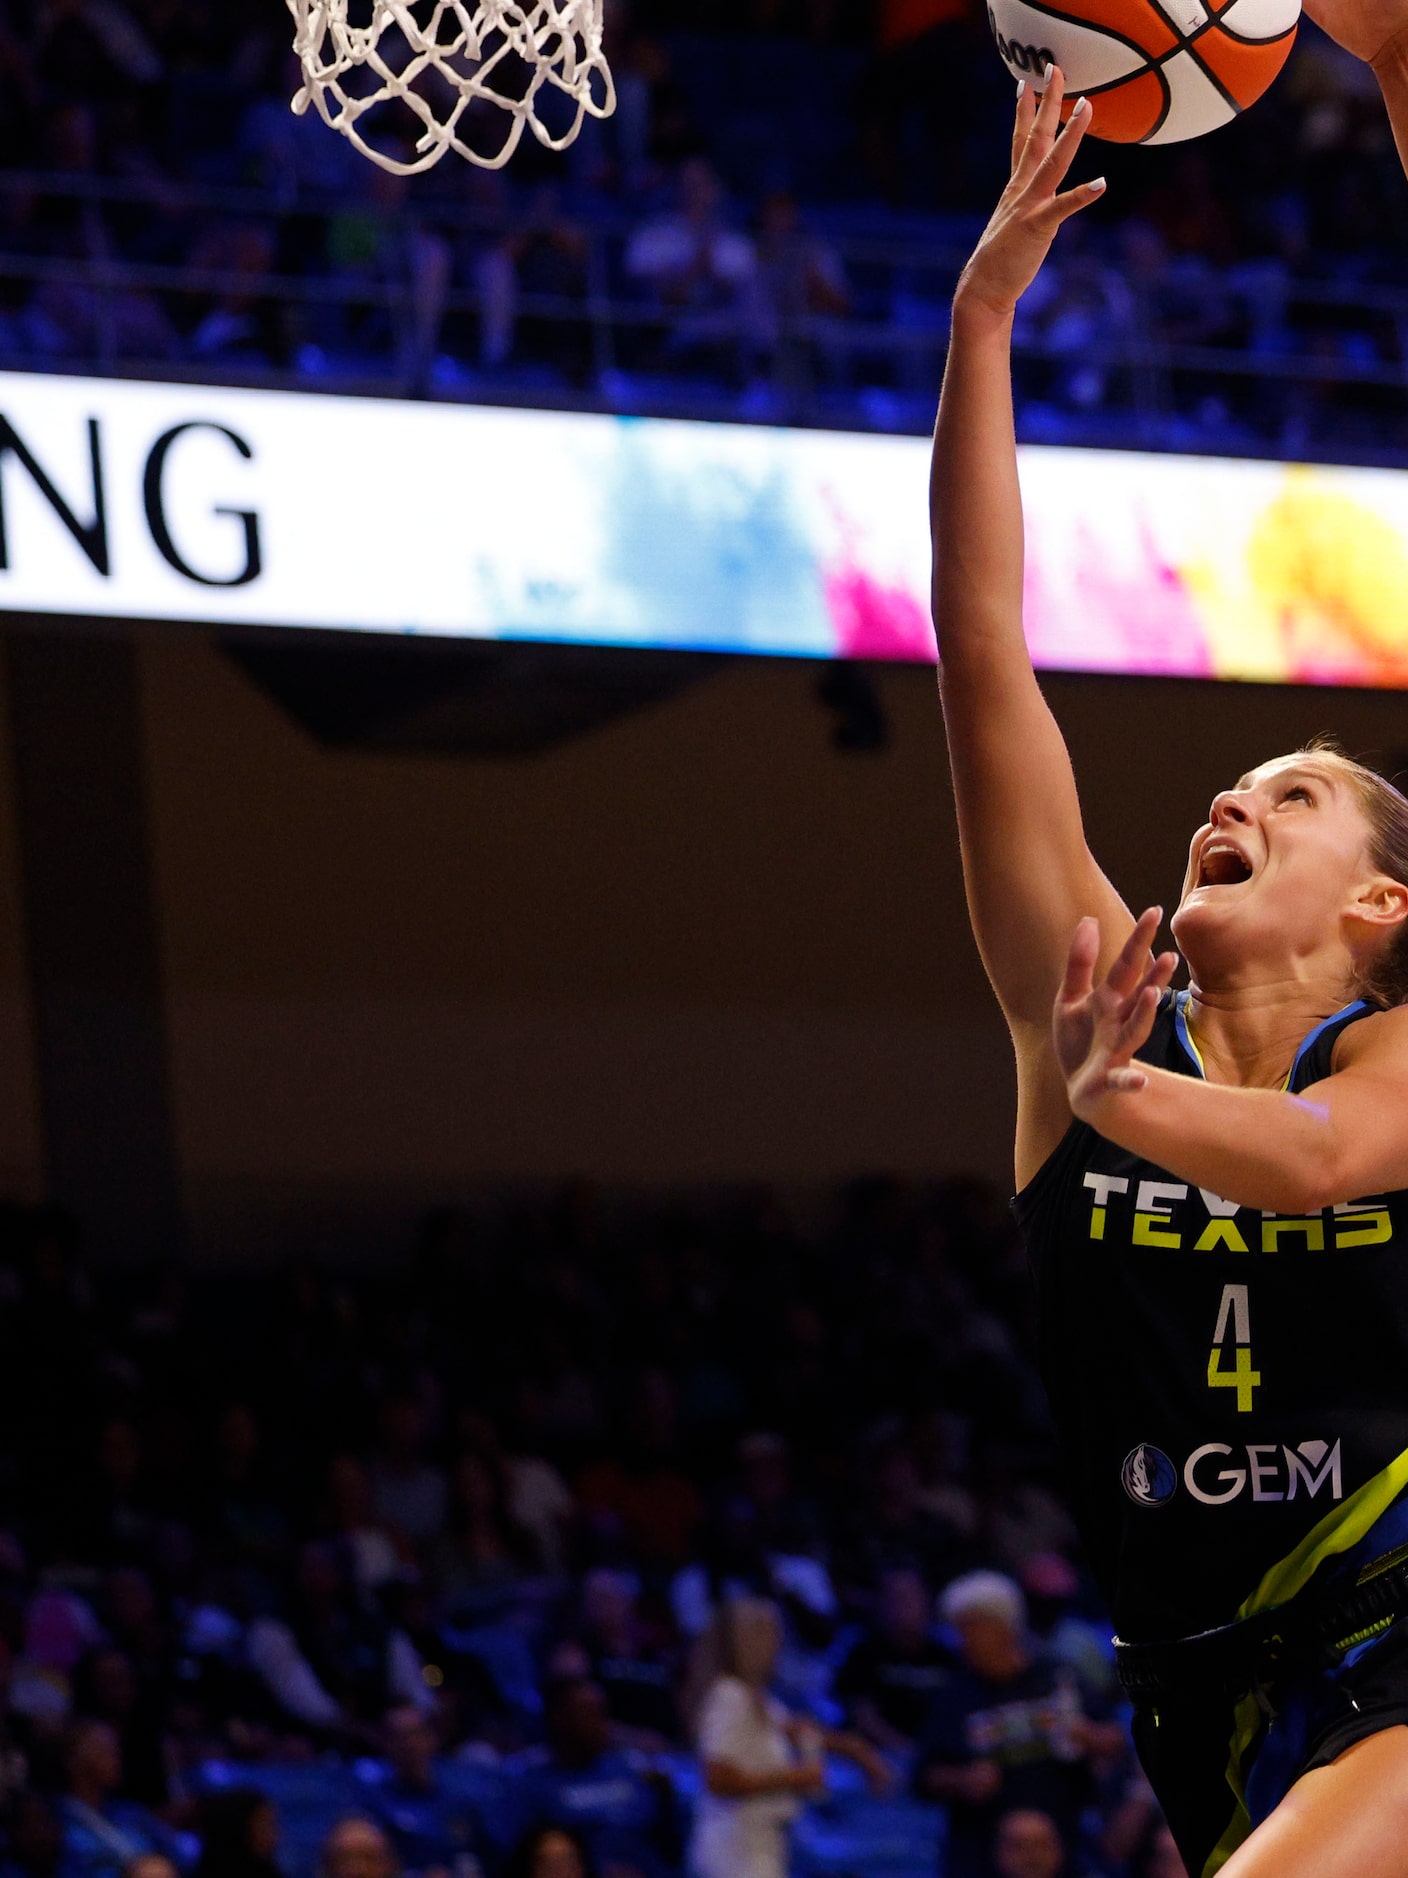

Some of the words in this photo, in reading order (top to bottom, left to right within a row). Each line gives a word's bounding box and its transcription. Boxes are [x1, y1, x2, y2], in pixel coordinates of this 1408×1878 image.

[0, 413, 261, 586] NG
[1207, 1283, 1261, 1412] 4
[1183, 1437, 1342, 1505] GEM
